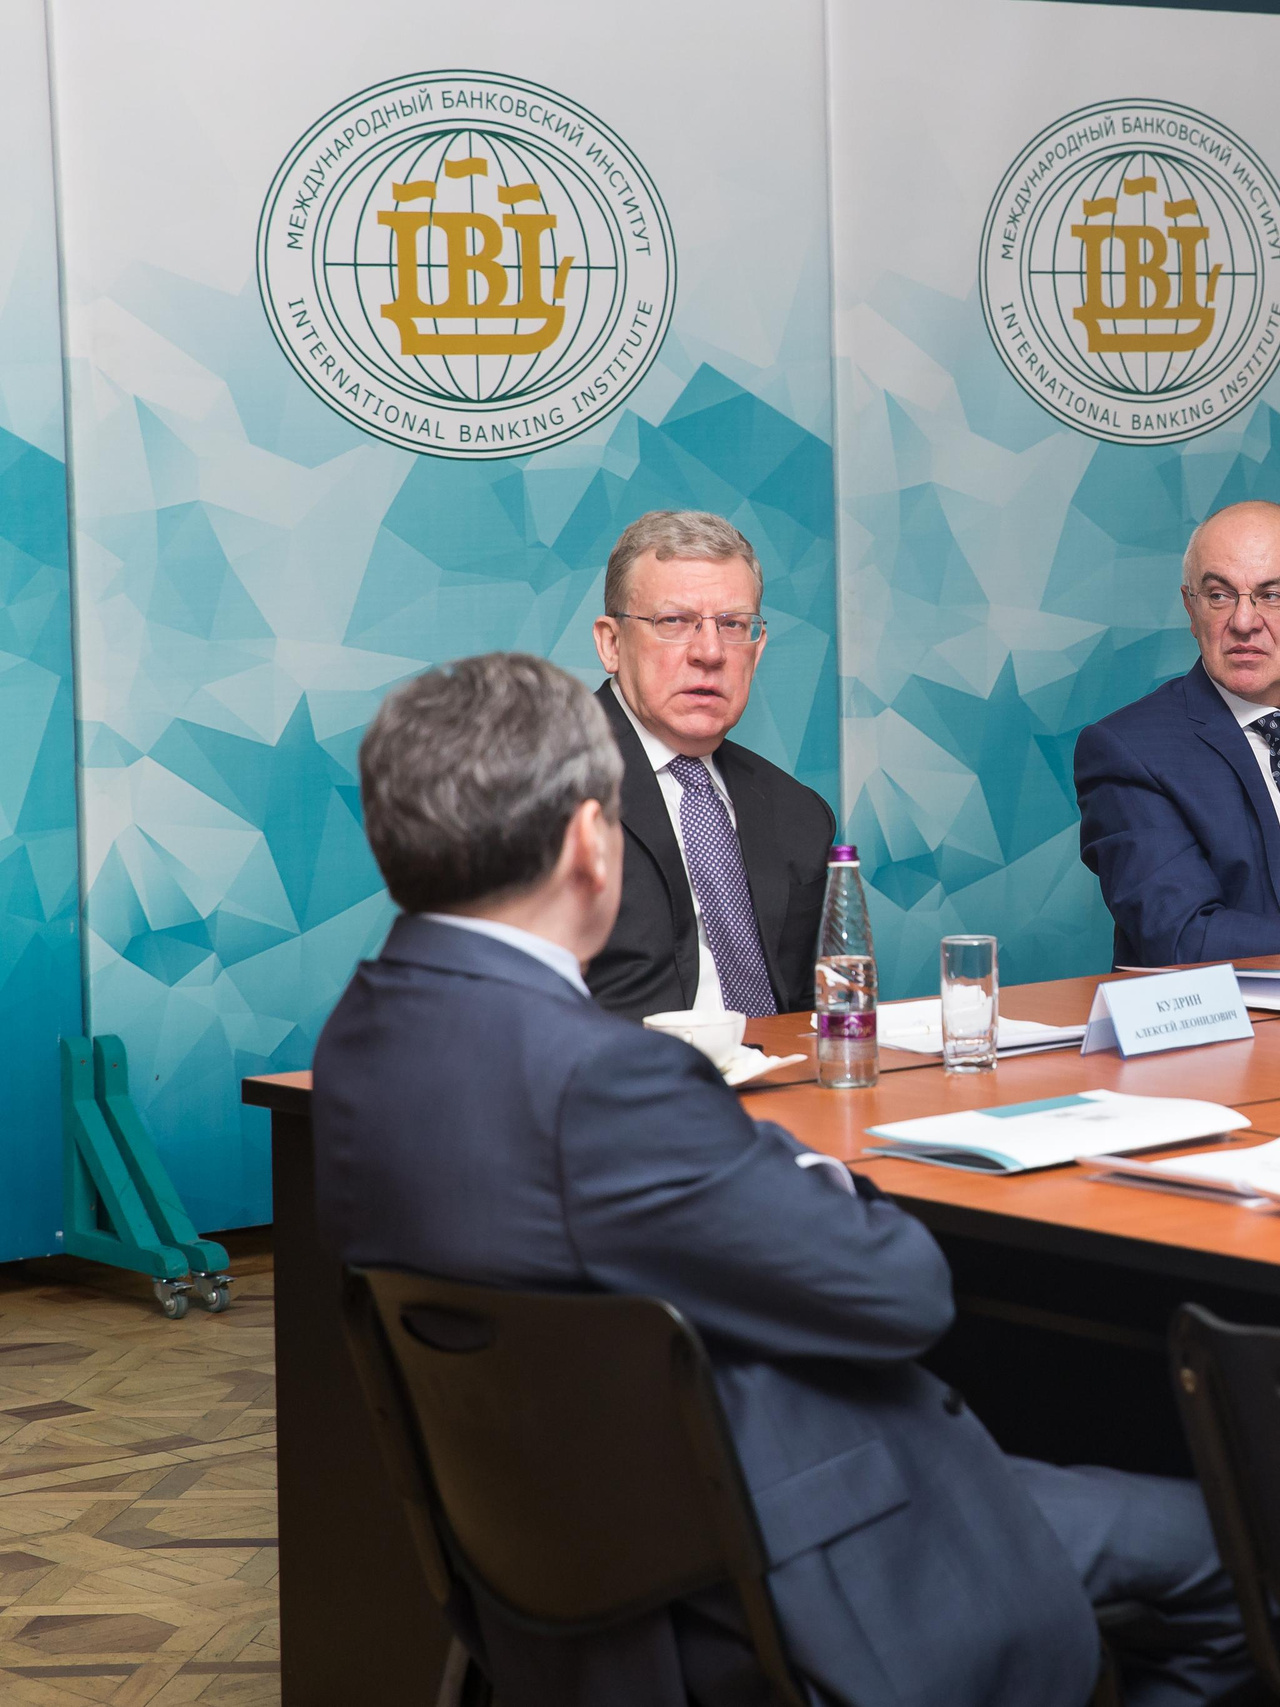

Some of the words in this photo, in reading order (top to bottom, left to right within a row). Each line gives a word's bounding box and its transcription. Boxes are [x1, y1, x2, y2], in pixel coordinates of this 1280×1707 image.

[287, 88, 434, 250] МЕЖДУНАРОДНЫЙ
[441, 89, 586, 149] БАНКОВСКИЙ
[585, 142, 652, 256] ИНСТИТУТ
[1001, 116, 1116, 260] МЕЖДУНАРОДНЫЙ
[1122, 116, 1233, 166] БАНКОВСКИЙ
[288, 297, 446, 441] INTERNATIONAL
[459, 407, 565, 443] BANKING
[572, 300, 653, 413] INSTITUTE
[1001, 302, 1121, 429] INTERNATIONAL
[1131, 399, 1214, 431] BANKING
[1134, 1020, 1178, 1040] АЛЕКСЕЙ
[1178, 1010, 1238, 1031] ЛЕОНИДОВИЧ
[1156, 993, 1203, 1013] КУДРИН
